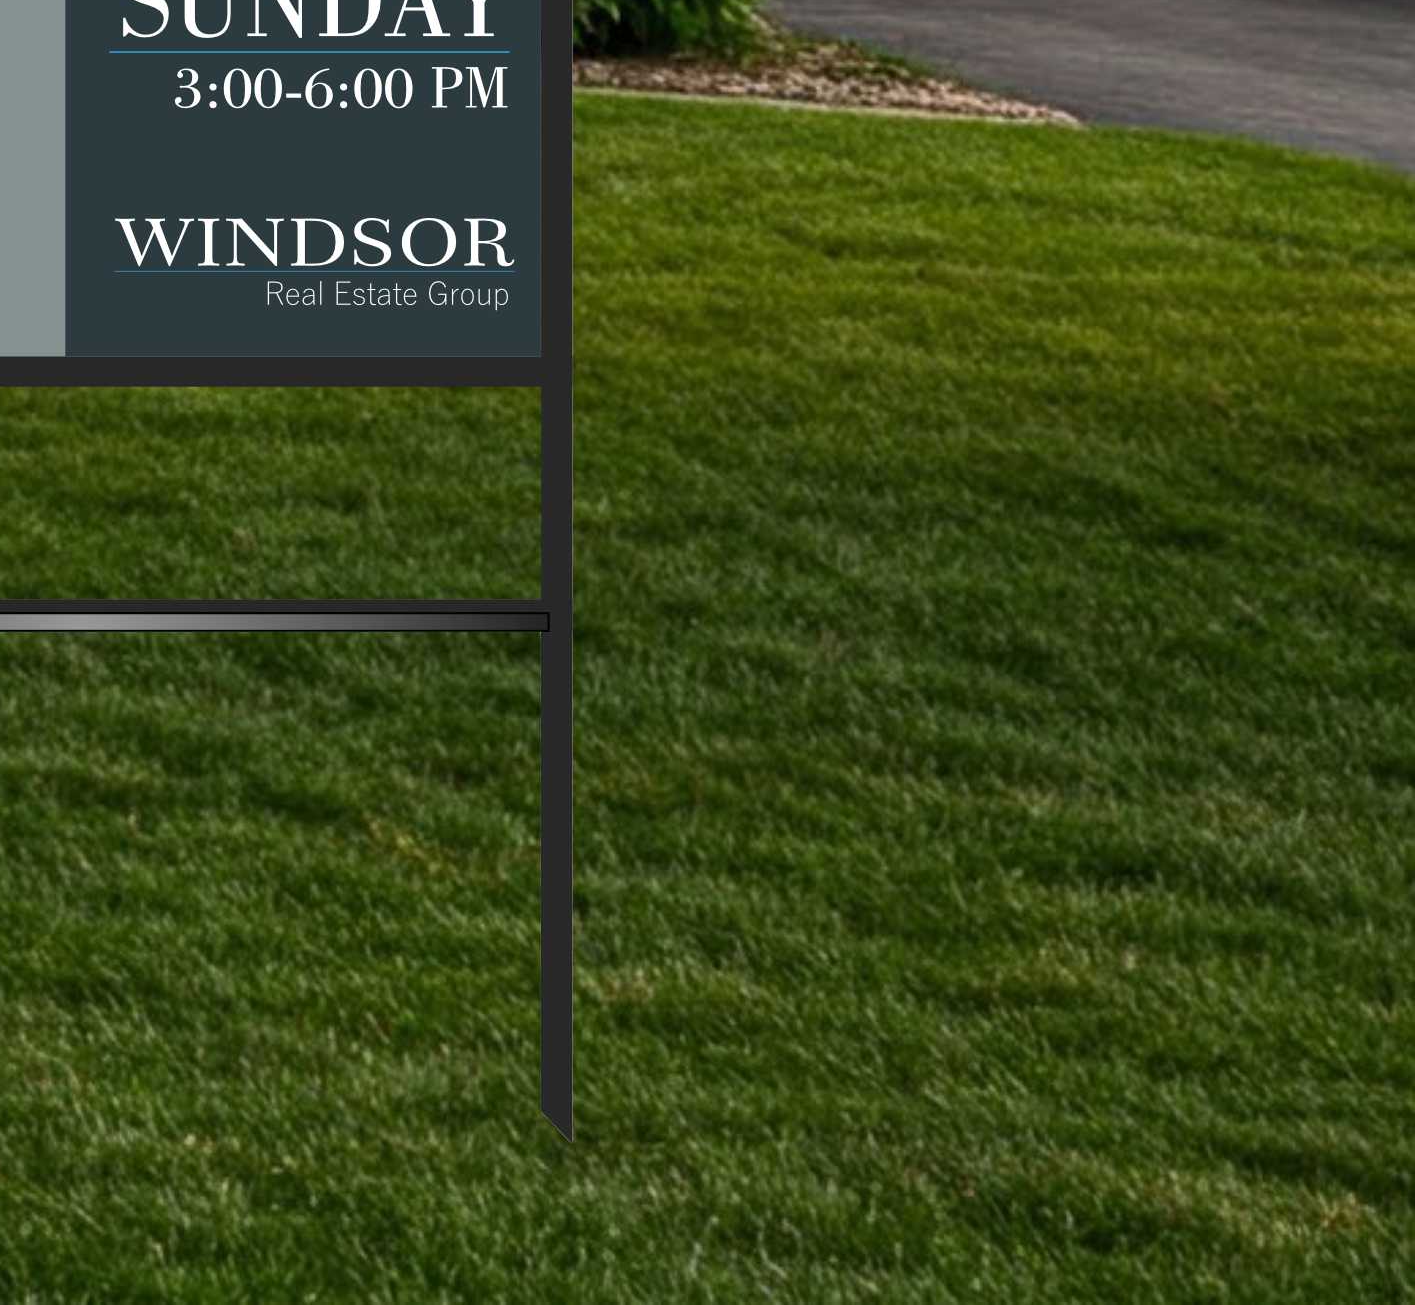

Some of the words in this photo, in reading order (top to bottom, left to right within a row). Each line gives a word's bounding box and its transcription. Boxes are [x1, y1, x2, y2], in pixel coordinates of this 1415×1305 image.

[174, 68, 414, 110] 3:00-6:00
[431, 66, 508, 110] PM
[115, 216, 516, 269] WINDSOR
[267, 280, 324, 306] Real
[335, 280, 417, 306] Estate
[428, 280, 509, 312] Group
